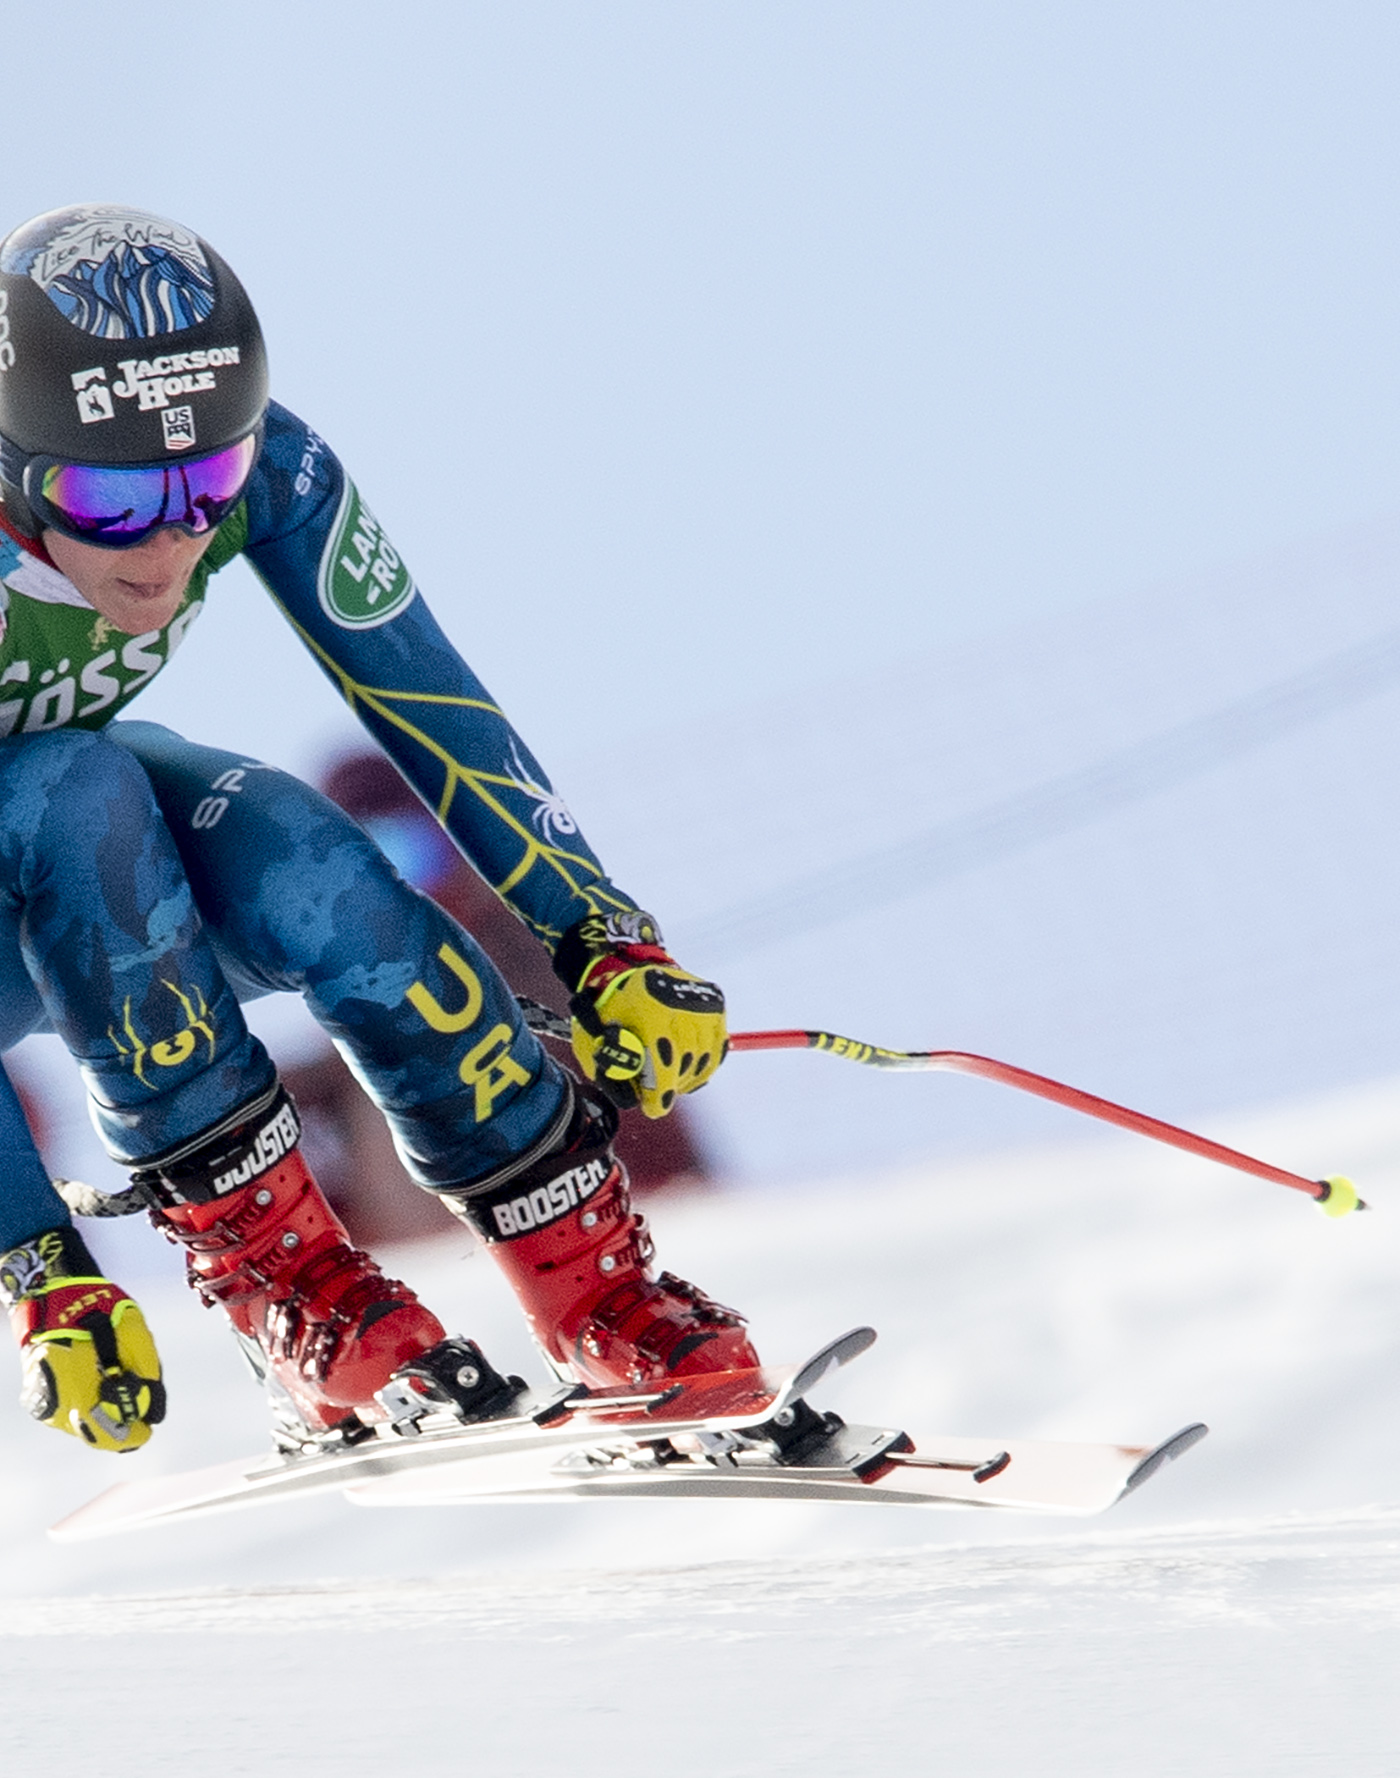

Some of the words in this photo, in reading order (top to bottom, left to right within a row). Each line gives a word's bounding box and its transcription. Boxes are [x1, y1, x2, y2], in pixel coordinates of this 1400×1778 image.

[112, 347, 240, 399] JACKSON
[137, 371, 217, 412] HOLE
[164, 409, 190, 425] US
[340, 500, 382, 583] LAN
